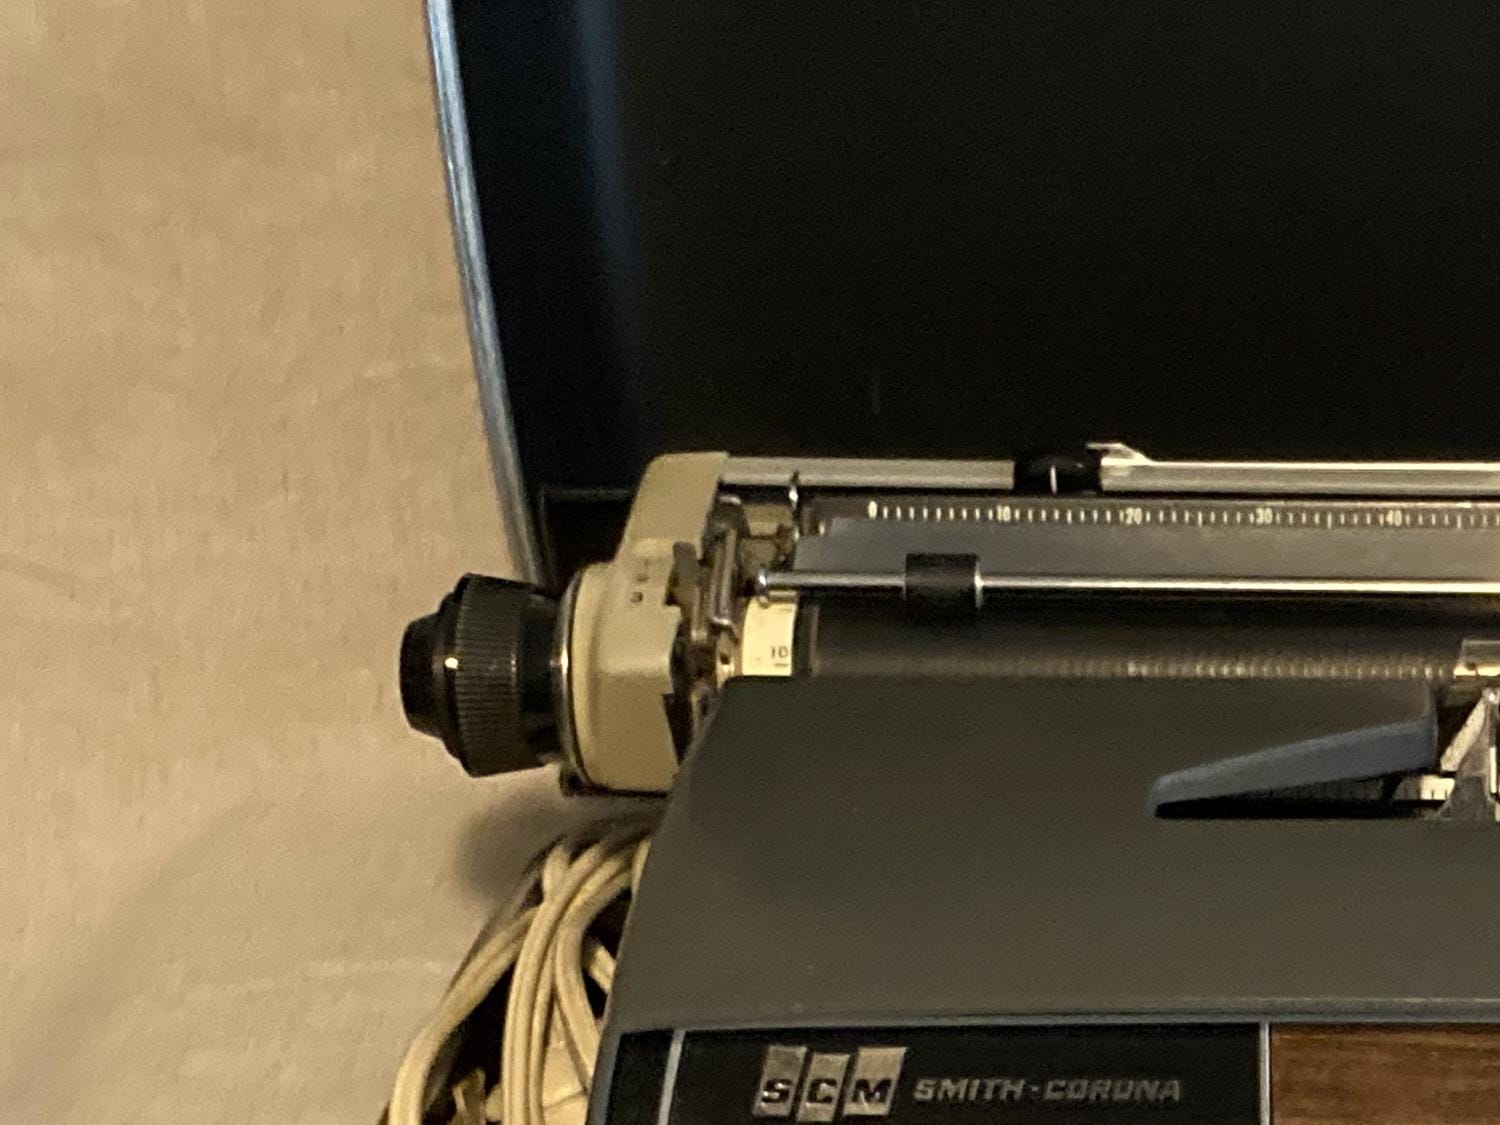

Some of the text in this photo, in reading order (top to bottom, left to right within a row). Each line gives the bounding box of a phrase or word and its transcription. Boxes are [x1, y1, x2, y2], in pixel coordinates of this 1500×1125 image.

[1255, 508, 1273, 525] 30
[1386, 509, 1402, 526] 40
[771, 646, 788, 659] 10
